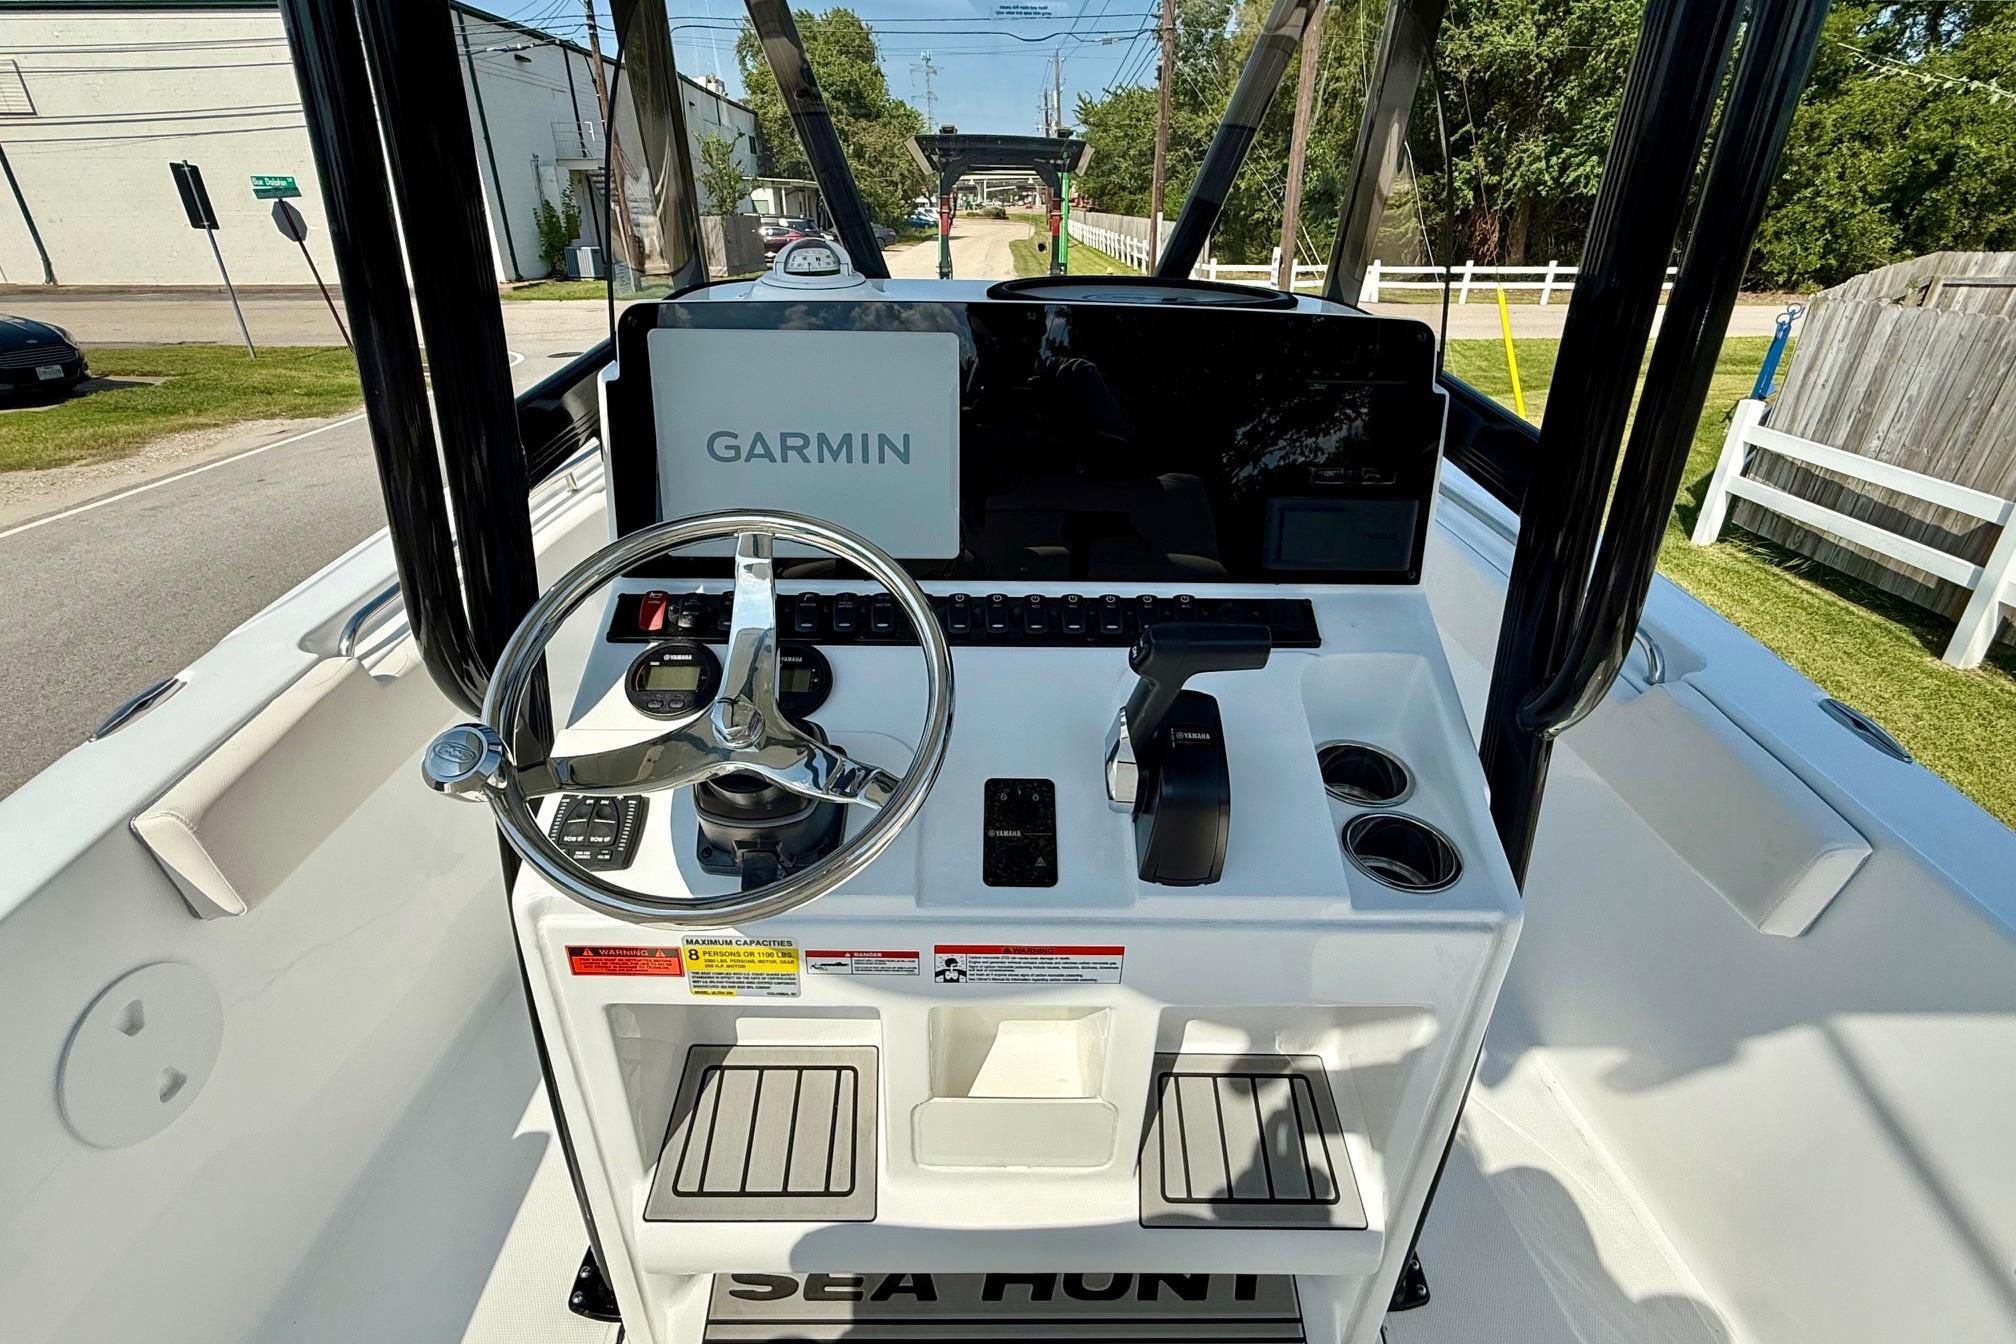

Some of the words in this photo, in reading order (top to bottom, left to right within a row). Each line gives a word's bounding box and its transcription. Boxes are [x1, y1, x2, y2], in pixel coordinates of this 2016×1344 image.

[706, 430, 910, 465] GARMIN
[1183, 732, 1211, 740] YAMAHA
[688, 948, 700, 960] 8
[776, 951, 795, 959] LBS.
[728, 1273, 938, 1302] SEA
